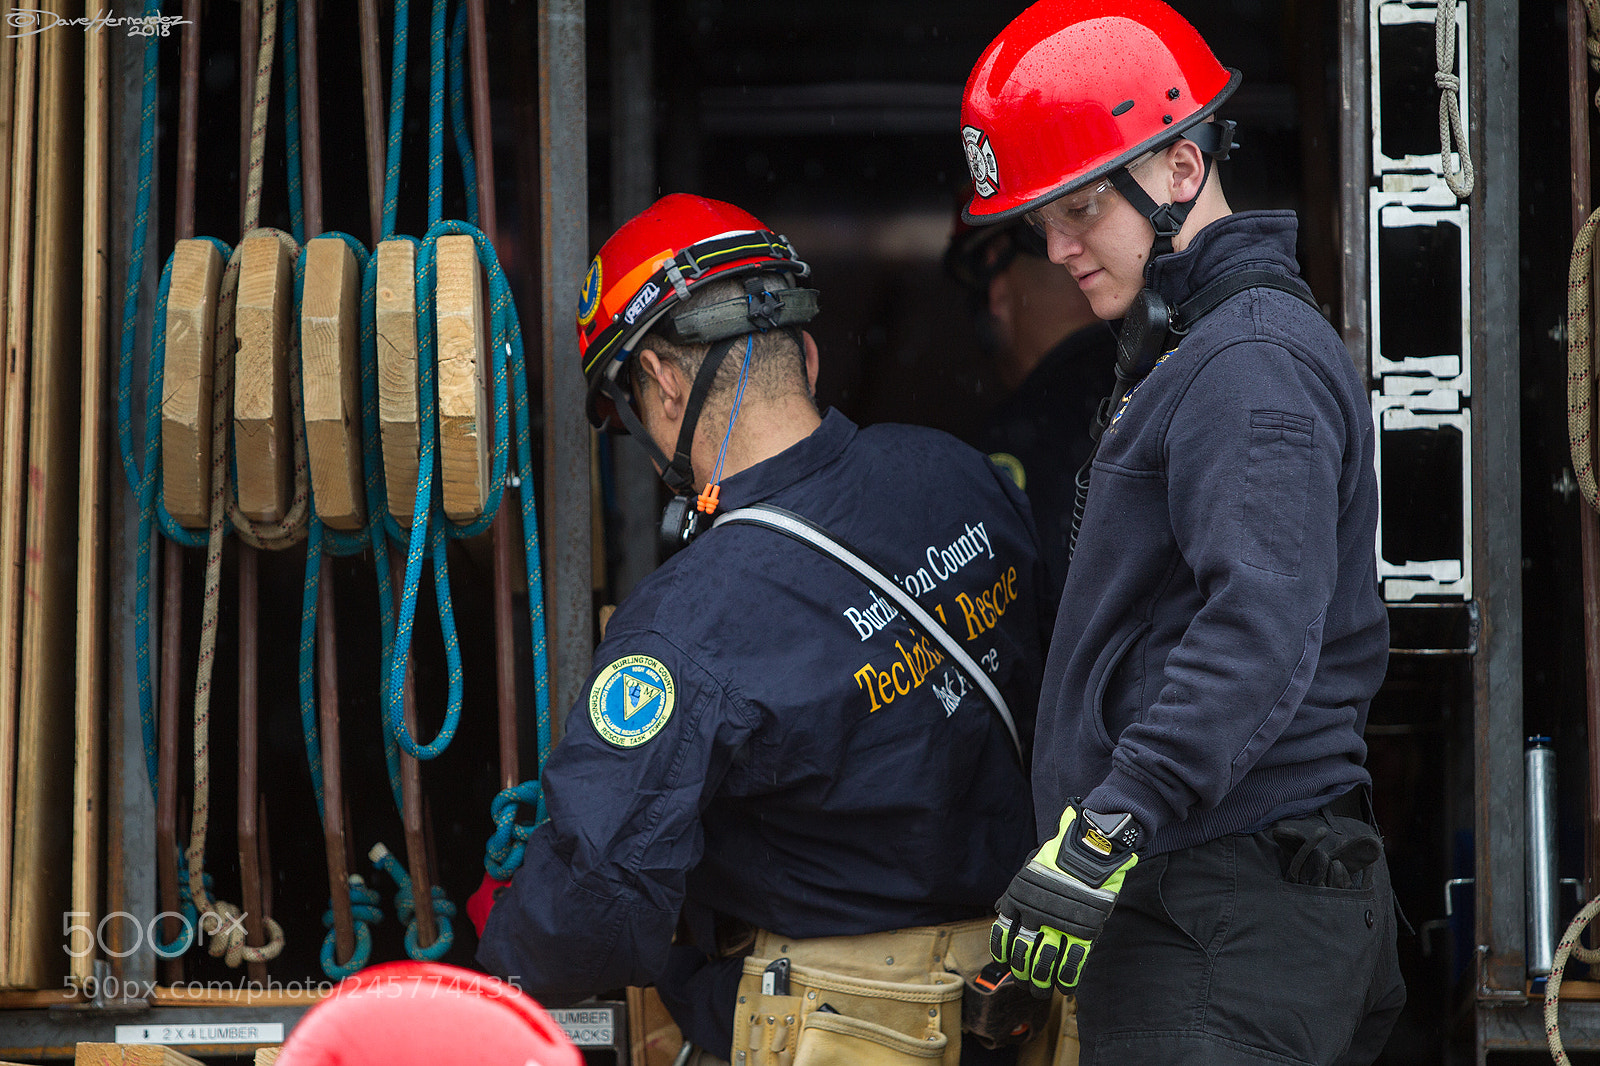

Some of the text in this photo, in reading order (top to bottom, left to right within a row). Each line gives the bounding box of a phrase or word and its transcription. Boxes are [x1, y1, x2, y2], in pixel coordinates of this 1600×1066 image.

[625, 283, 660, 323] PETZL
[926, 521, 995, 581] County
[612, 657, 673, 695] BURLINGTON COUNTY
[591, 686, 602, 726] TECHNICAL
[600, 727, 626, 744] RESCUE
[630, 734, 646, 745] TASK
[649, 715, 667, 735] FORCE
[162, 1026, 259, 1039] 2 X 4 LUMBER
